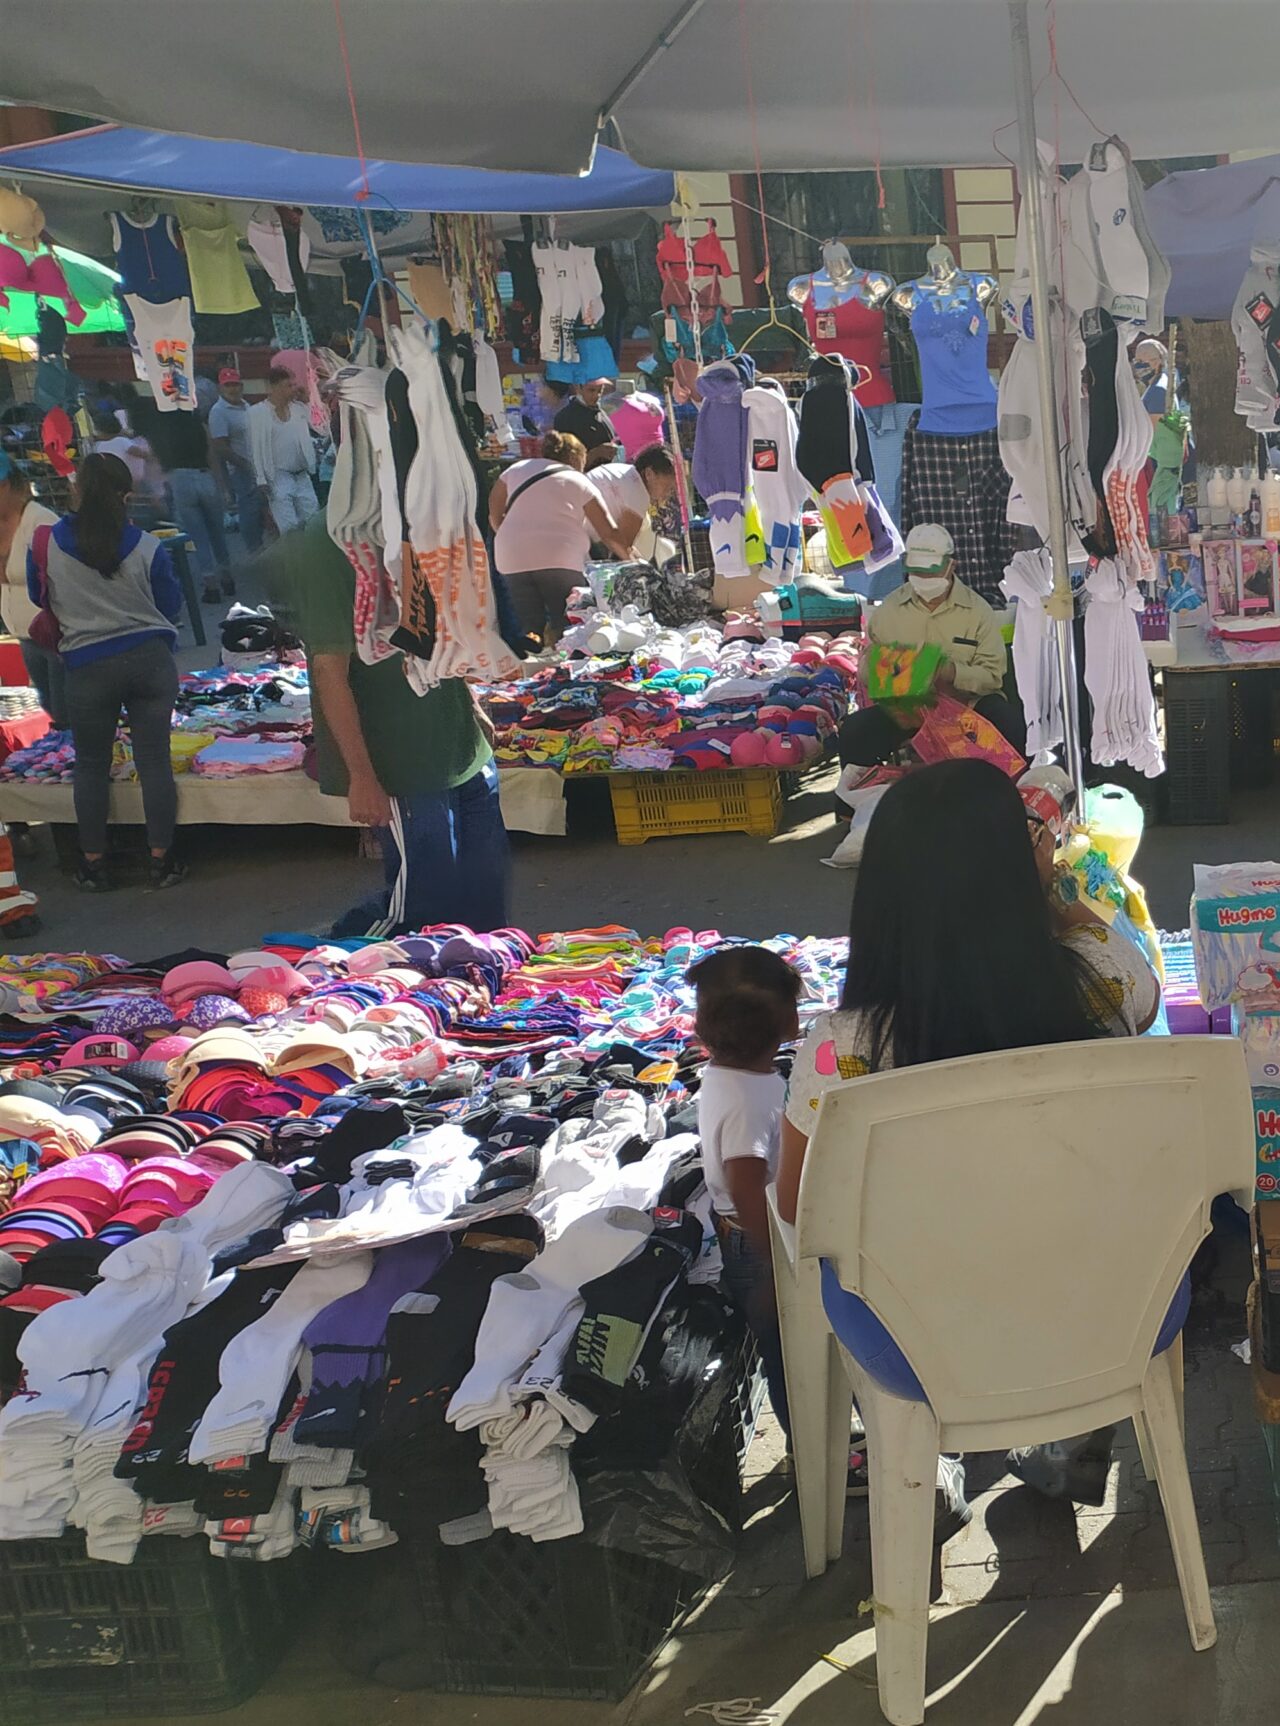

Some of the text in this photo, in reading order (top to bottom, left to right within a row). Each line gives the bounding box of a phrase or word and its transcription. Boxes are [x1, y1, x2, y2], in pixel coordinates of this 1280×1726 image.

[1217, 907, 1276, 926] Hugme
[1259, 1177, 1274, 1187] 20
[144, 1506, 171, 1528] 23
